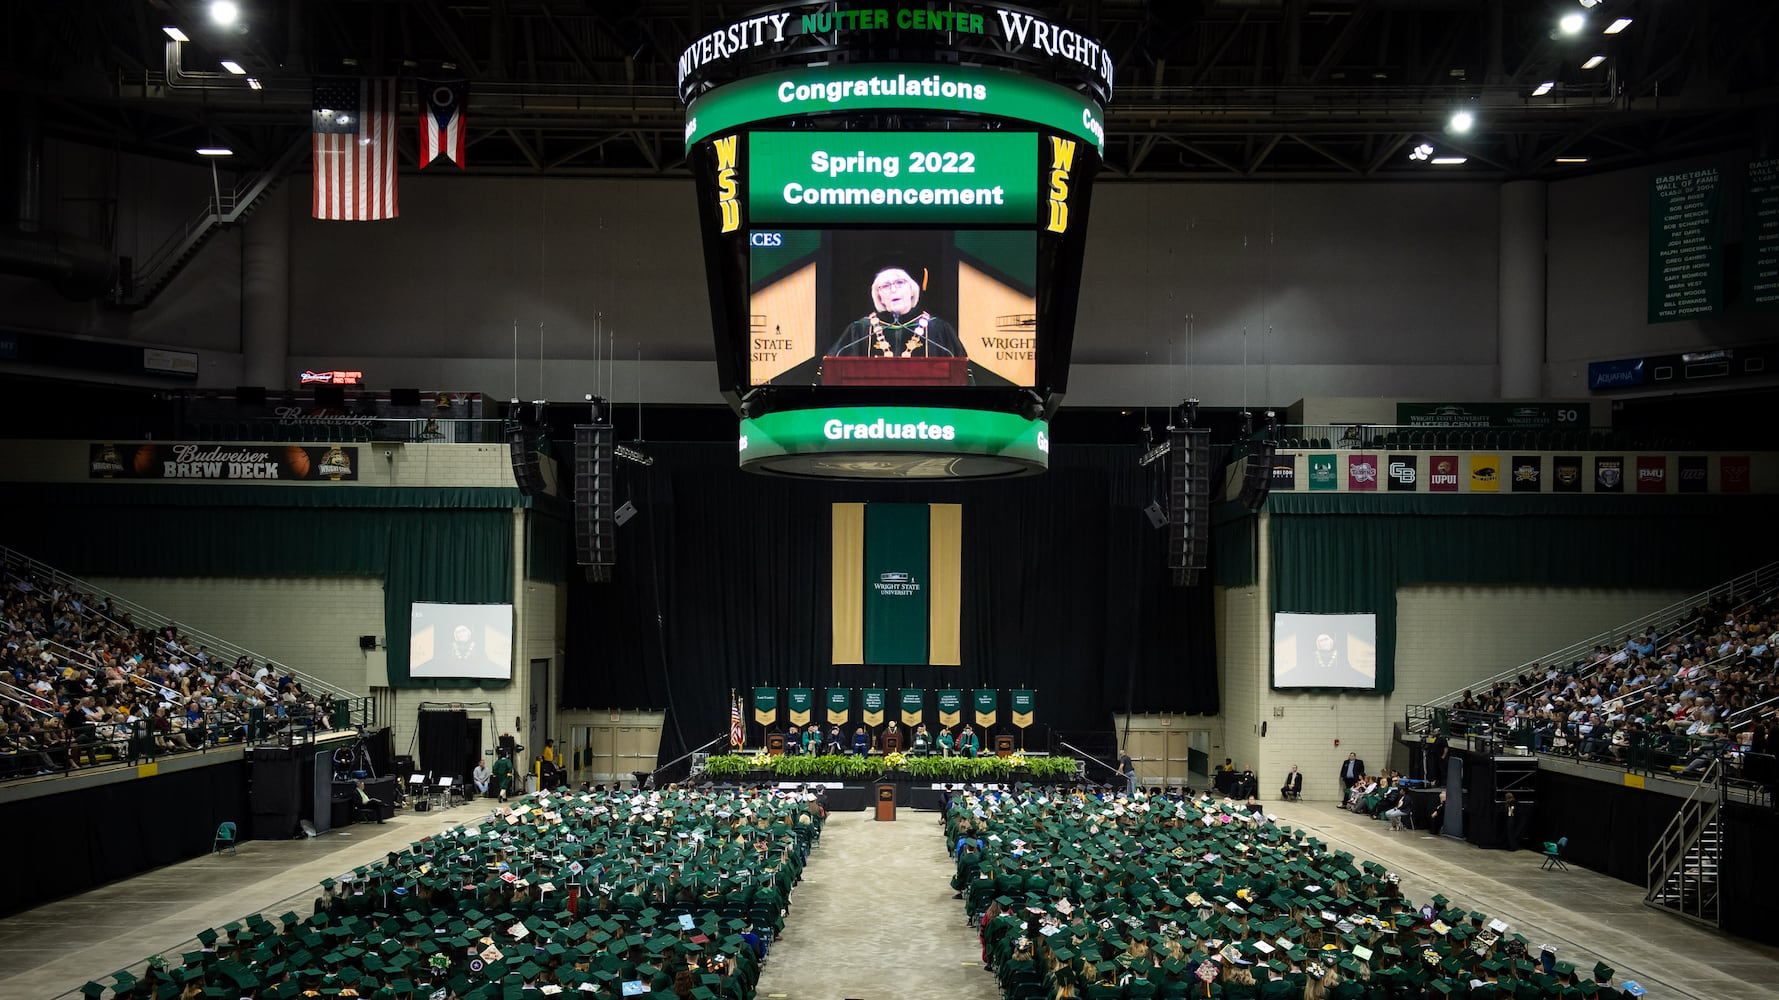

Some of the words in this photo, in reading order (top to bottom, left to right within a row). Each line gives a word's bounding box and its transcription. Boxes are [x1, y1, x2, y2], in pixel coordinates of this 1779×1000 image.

[802, 9, 889, 35] NUTTER
[897, 9, 983, 35] CENTER
[997, 10, 1099, 71] WRIGHT
[778, 75, 987, 103] Congratulations
[811, 151, 899, 177] Spring
[908, 152, 976, 173] 2022
[1655, 168, 1718, 184] BASKETBALL
[1656, 182, 1677, 191] WALL
[1681, 180, 1693, 188] OF
[1696, 175, 1719, 185] FAME
[783, 183, 1004, 205] Commencement
[754, 339, 792, 350] STATE
[996, 352, 1035, 361] UNIVE
[1596, 371, 1633, 385] AQUAFINA
[274, 406, 378, 427] Budweiser
[1557, 409, 1577, 422] 50
[824, 418, 956, 441] Graduates
[173, 445, 269, 463] Budweiser
[164, 462, 222, 479] BREW
[229, 462, 279, 479] DECK
[1390, 462, 1415, 483] GB
[1640, 469, 1664, 479] RMU
[1431, 475, 1457, 485] IUPUI
